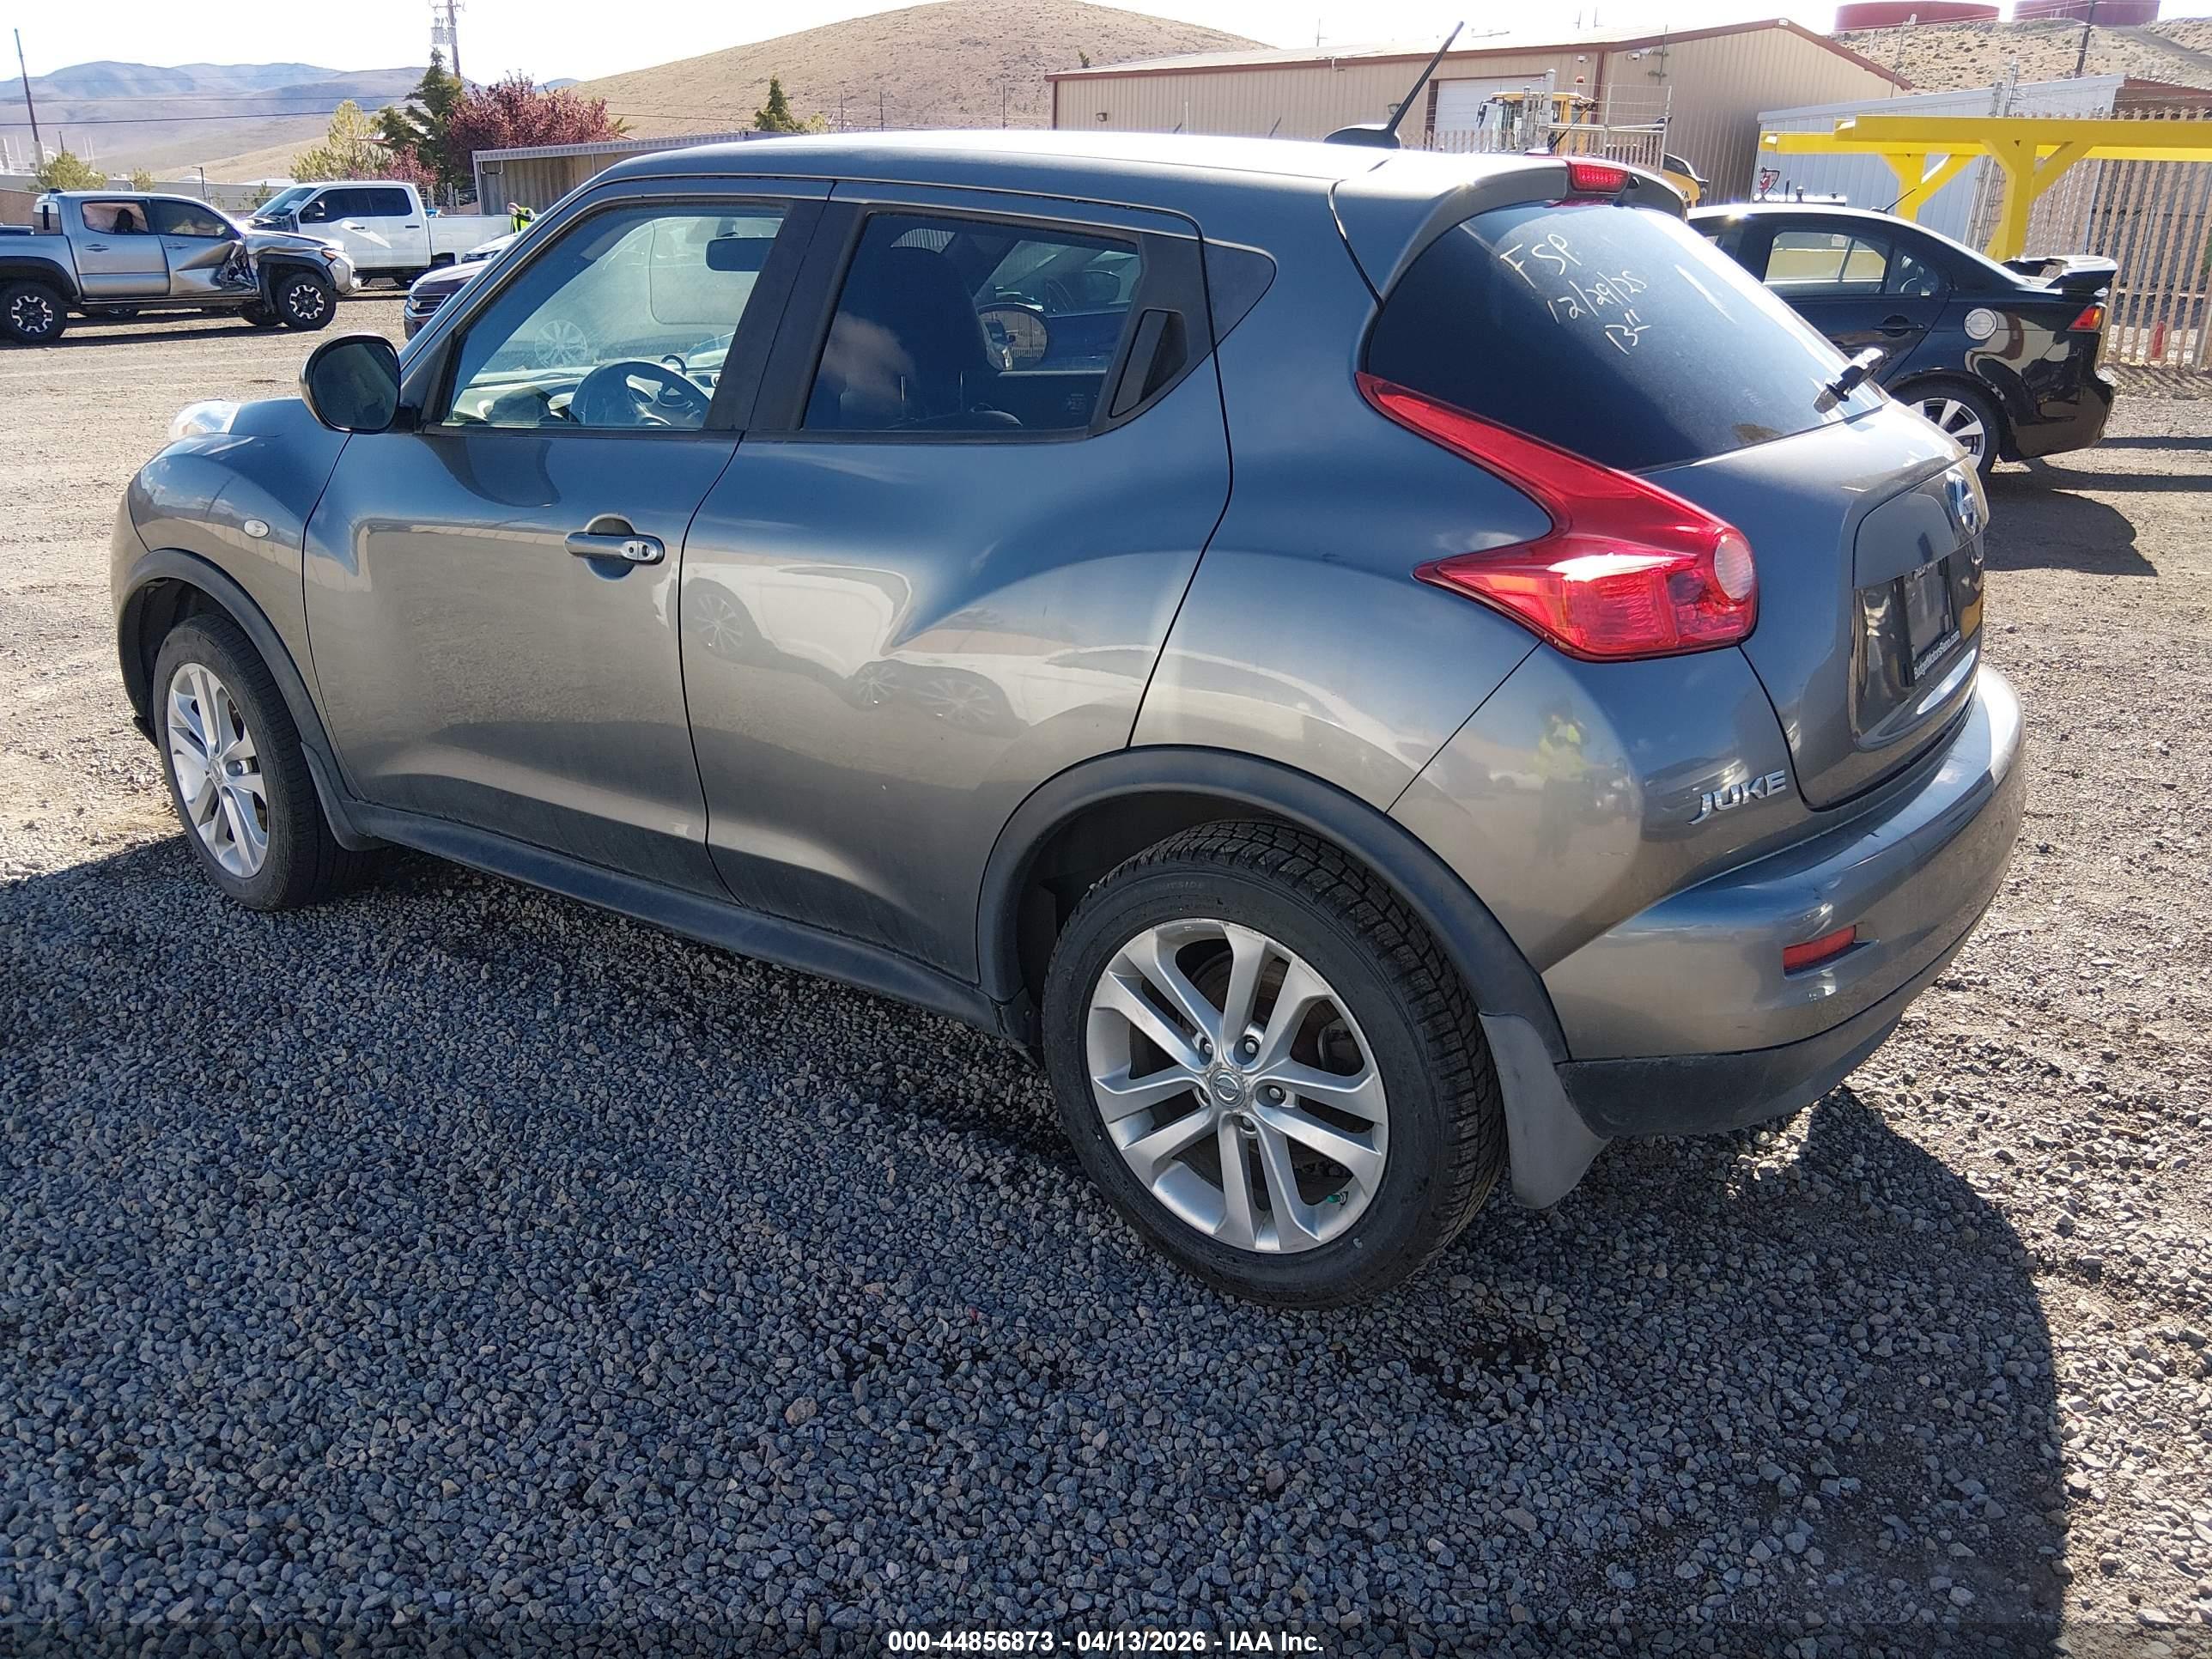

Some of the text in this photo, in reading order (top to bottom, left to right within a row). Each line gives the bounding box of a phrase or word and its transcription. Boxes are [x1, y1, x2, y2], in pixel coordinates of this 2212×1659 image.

[1547, 270, 1647, 324] 12/29/25
[1913, 629, 1960, 680] BudgetMotorsReno.com
[1687, 770, 1786, 824] JUKE
